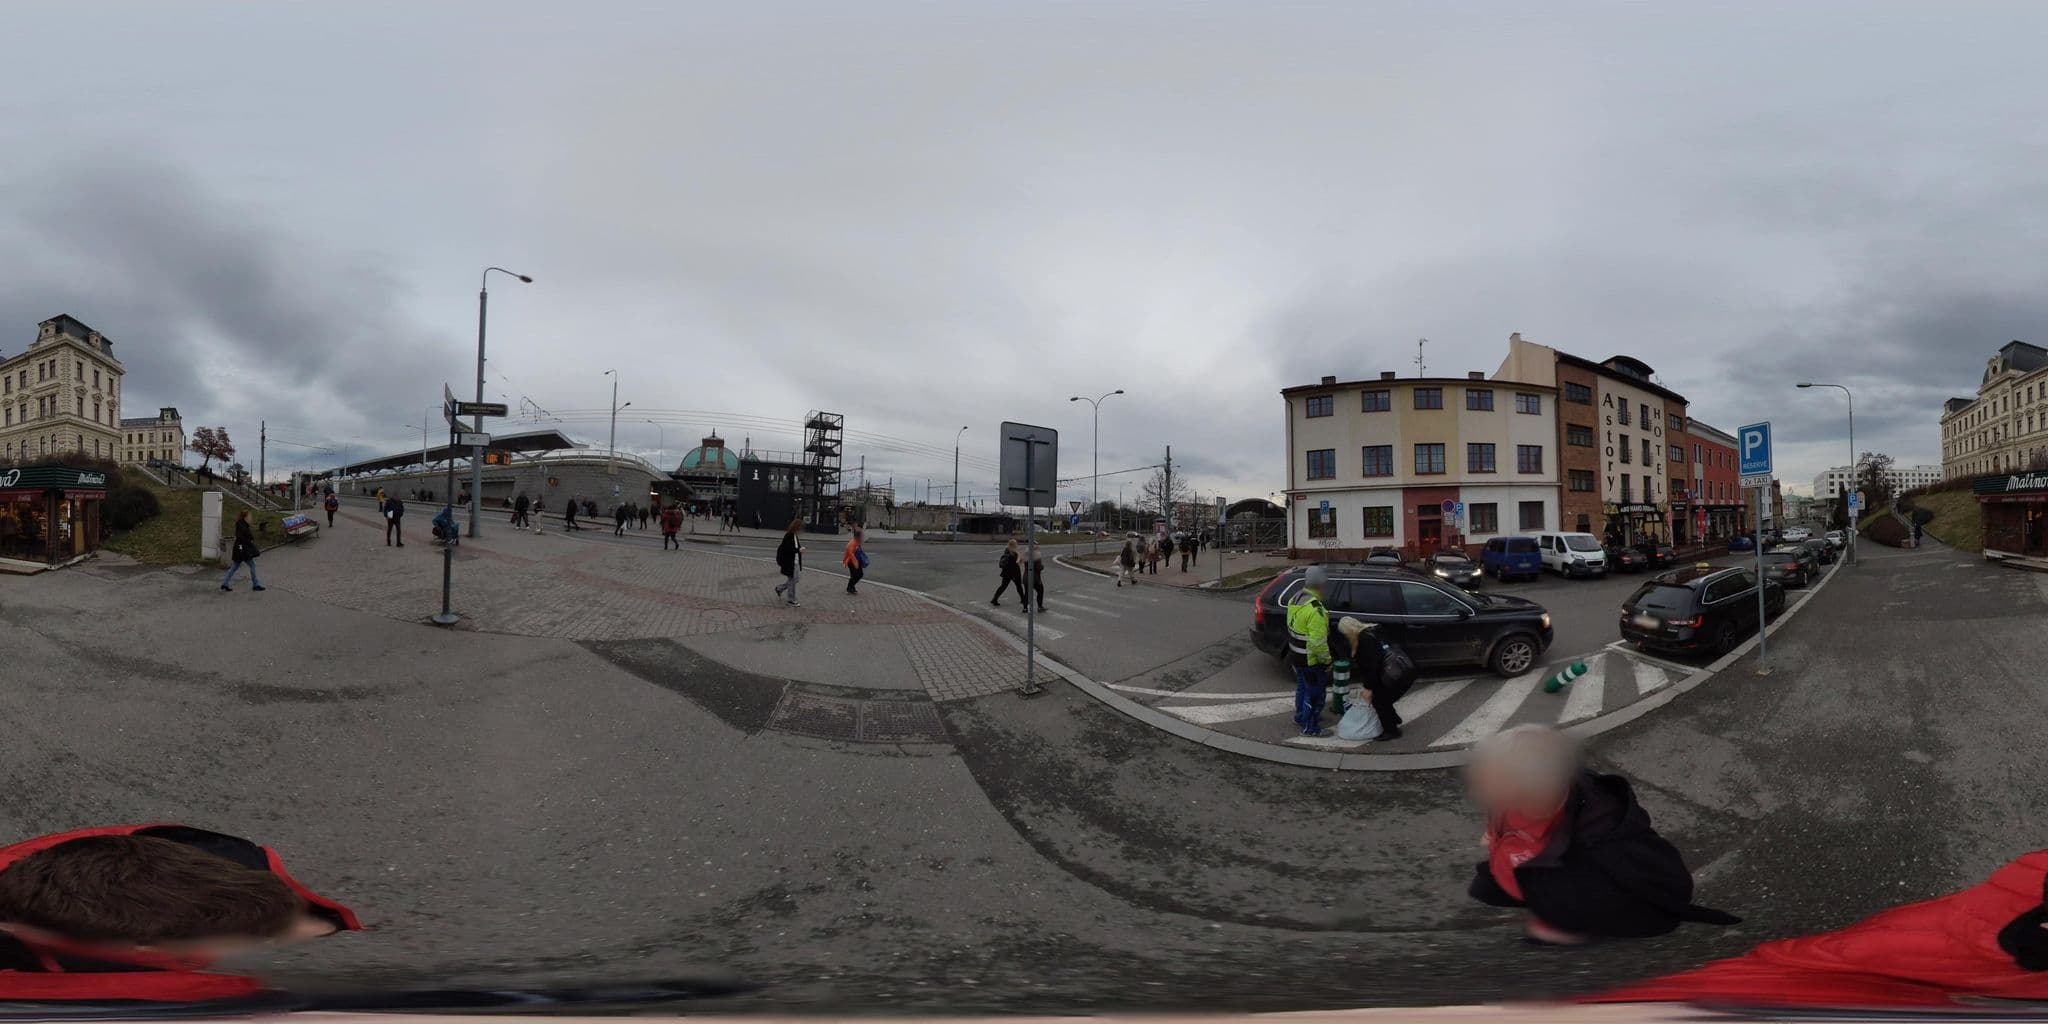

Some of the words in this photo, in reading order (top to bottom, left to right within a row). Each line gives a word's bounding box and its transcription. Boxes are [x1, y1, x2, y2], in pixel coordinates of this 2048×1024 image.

[1603, 392, 1615, 492] Astory
[1653, 408, 1662, 494] HOTEL
[1745, 431, 1763, 459] P
[1754, 476, 1768, 484] TAXI
